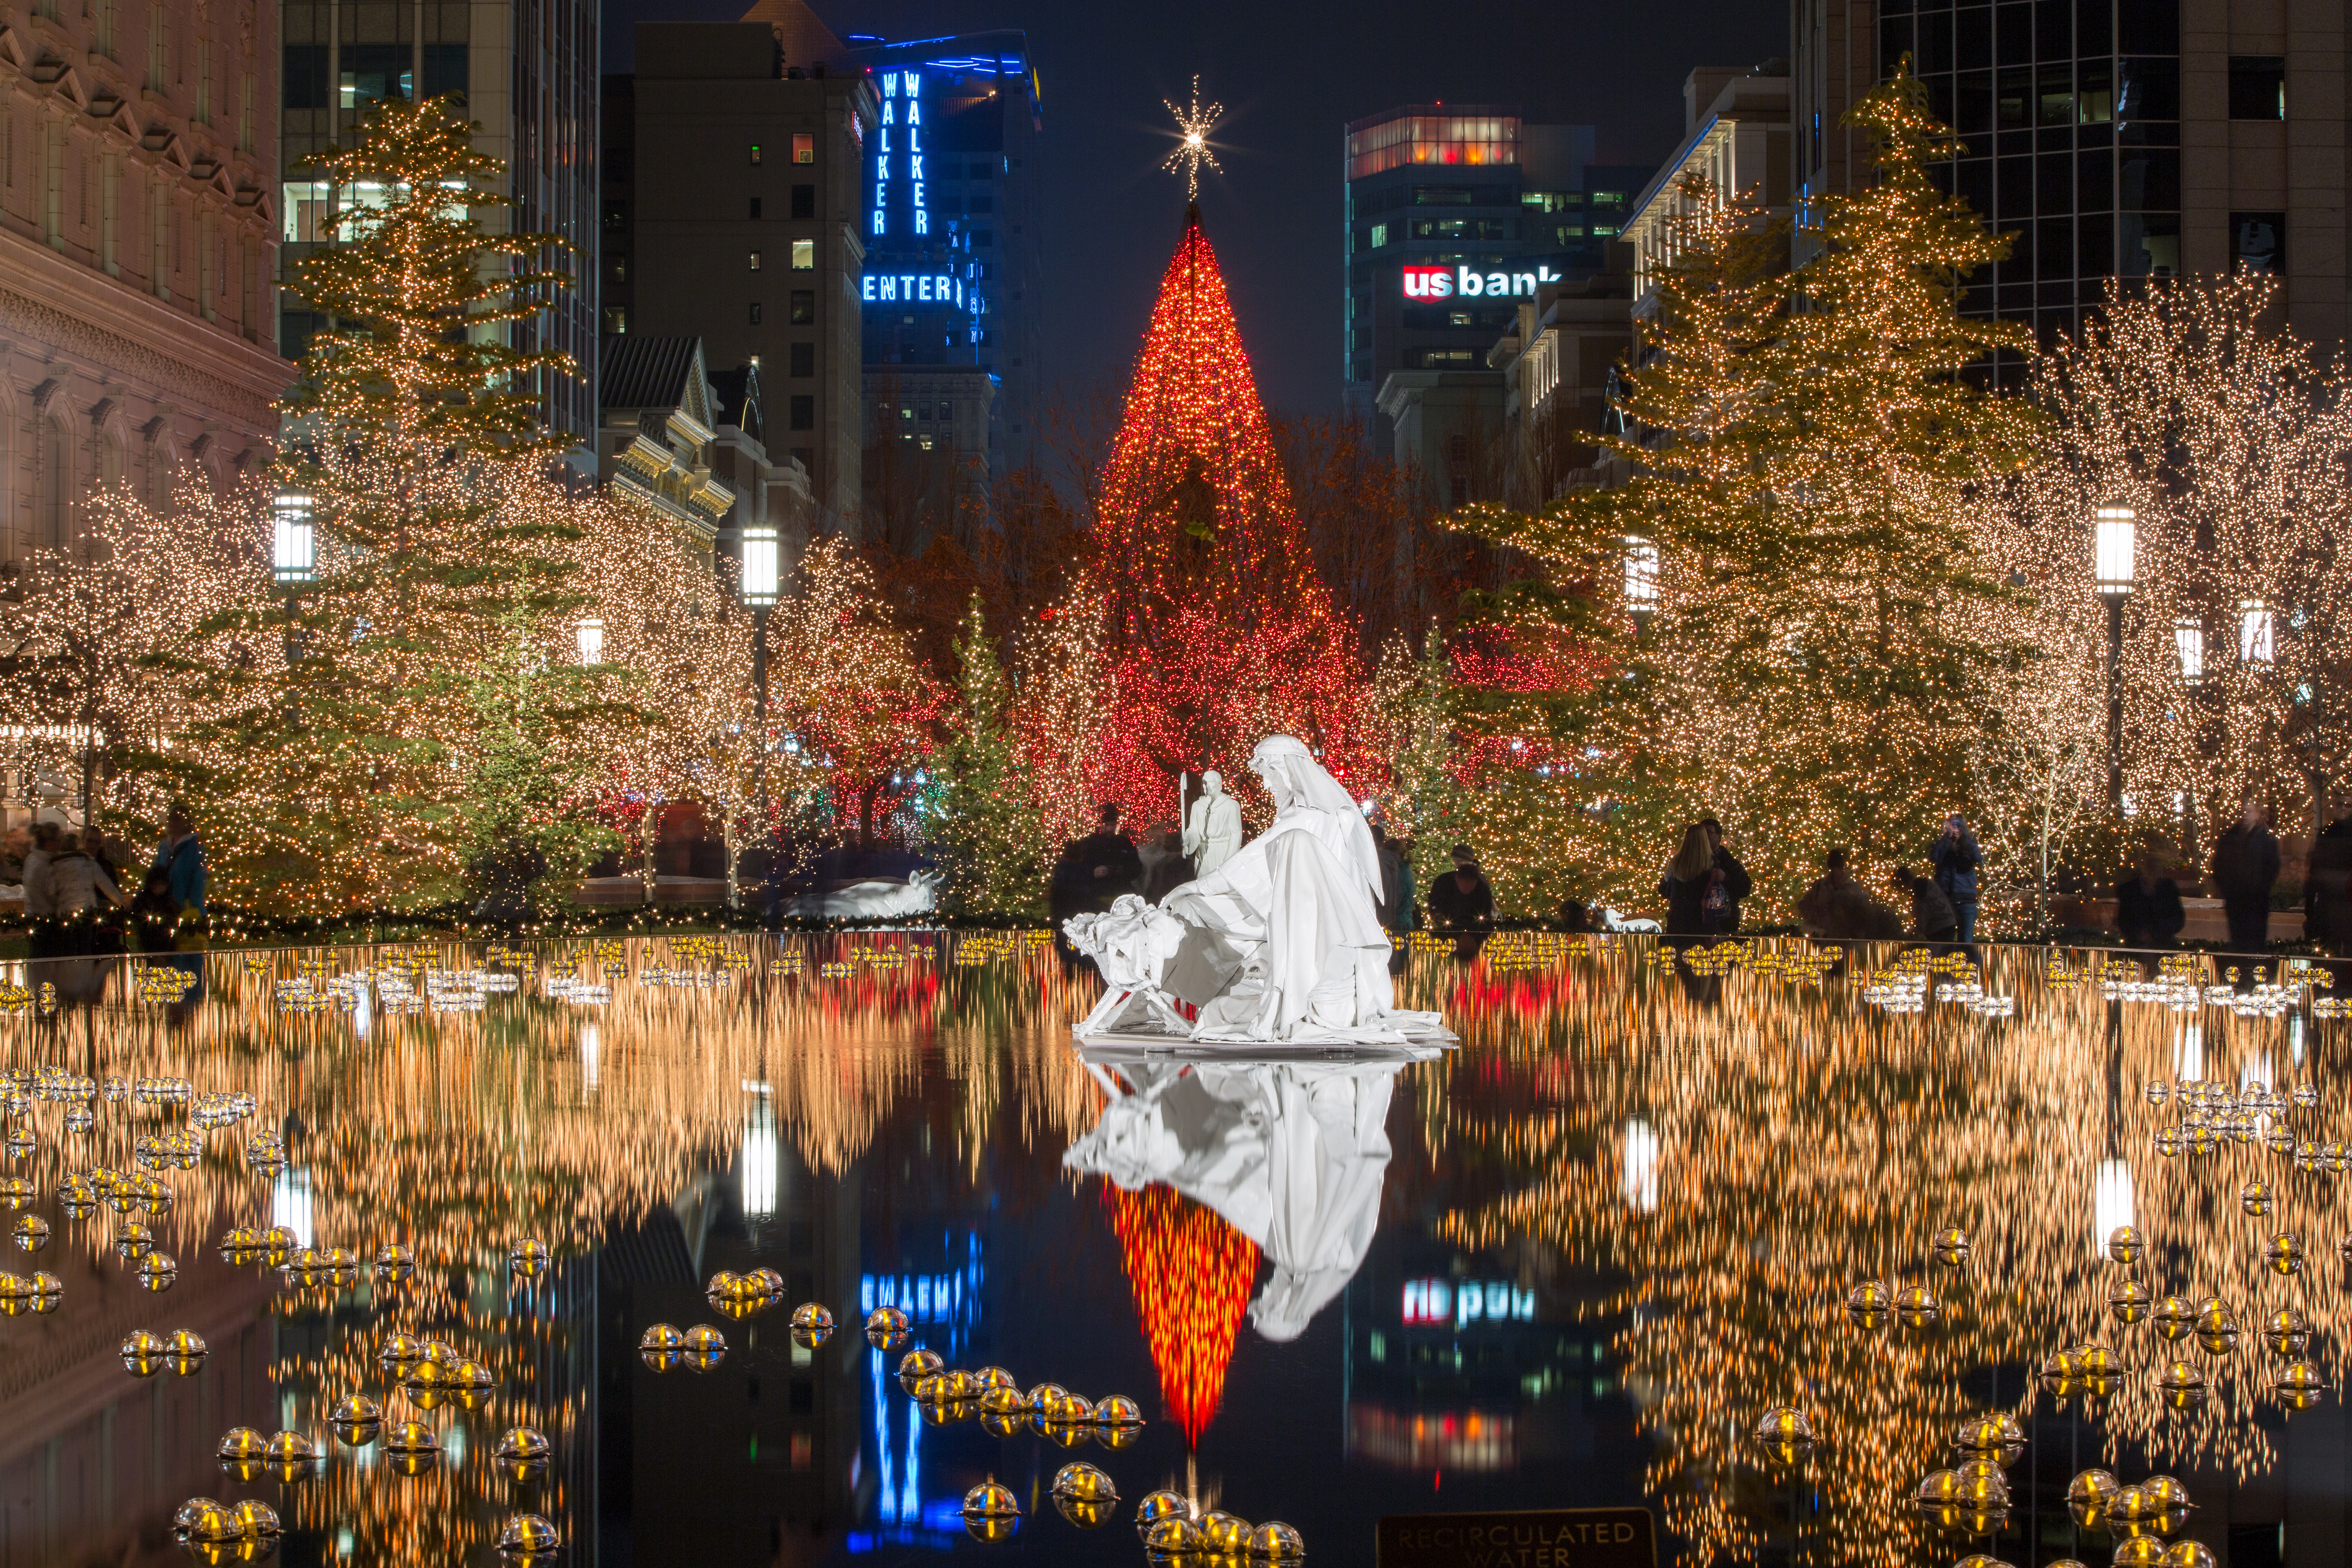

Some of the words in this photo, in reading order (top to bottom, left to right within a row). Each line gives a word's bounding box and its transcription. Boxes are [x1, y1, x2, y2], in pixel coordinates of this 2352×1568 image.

[874, 73, 897, 234] WALKER
[905, 73, 927, 234] WALKER
[1405, 272, 1453, 296] us
[1398, 1522, 1634, 1549] RECIRCULATED
[1464, 1548, 1570, 1568] WATER
